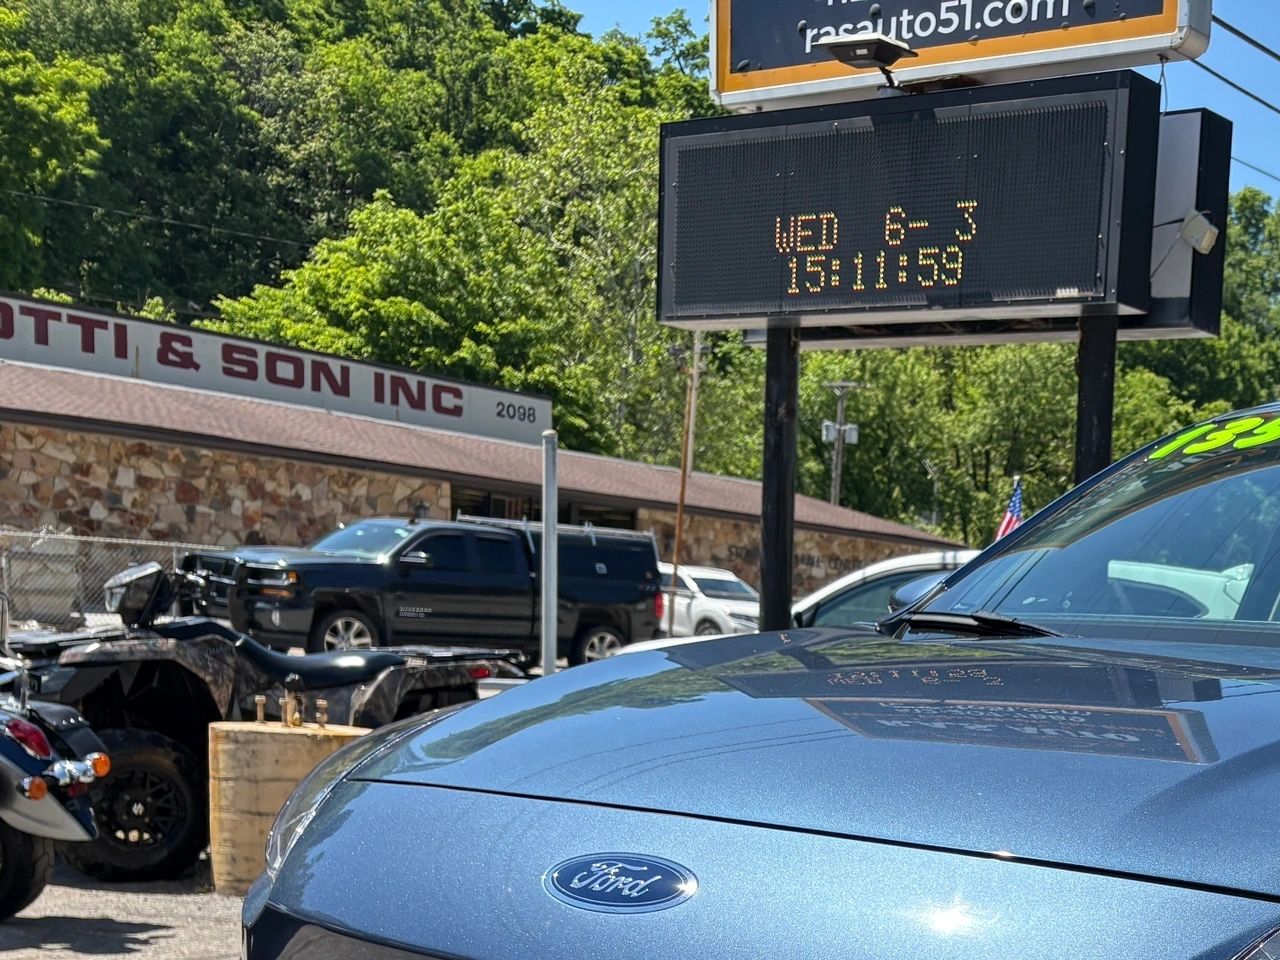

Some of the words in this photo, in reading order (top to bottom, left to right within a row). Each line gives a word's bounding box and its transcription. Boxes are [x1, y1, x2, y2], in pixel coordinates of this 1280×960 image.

[775, 211, 838, 253] WED
[787, 245, 963, 294] 15:11:59
[157, 331, 201, 371] &
[222, 343, 350, 397] SON
[374, 371, 463, 417] INC
[496, 401, 536, 424] 2098
[570, 860, 661, 897] Ford
